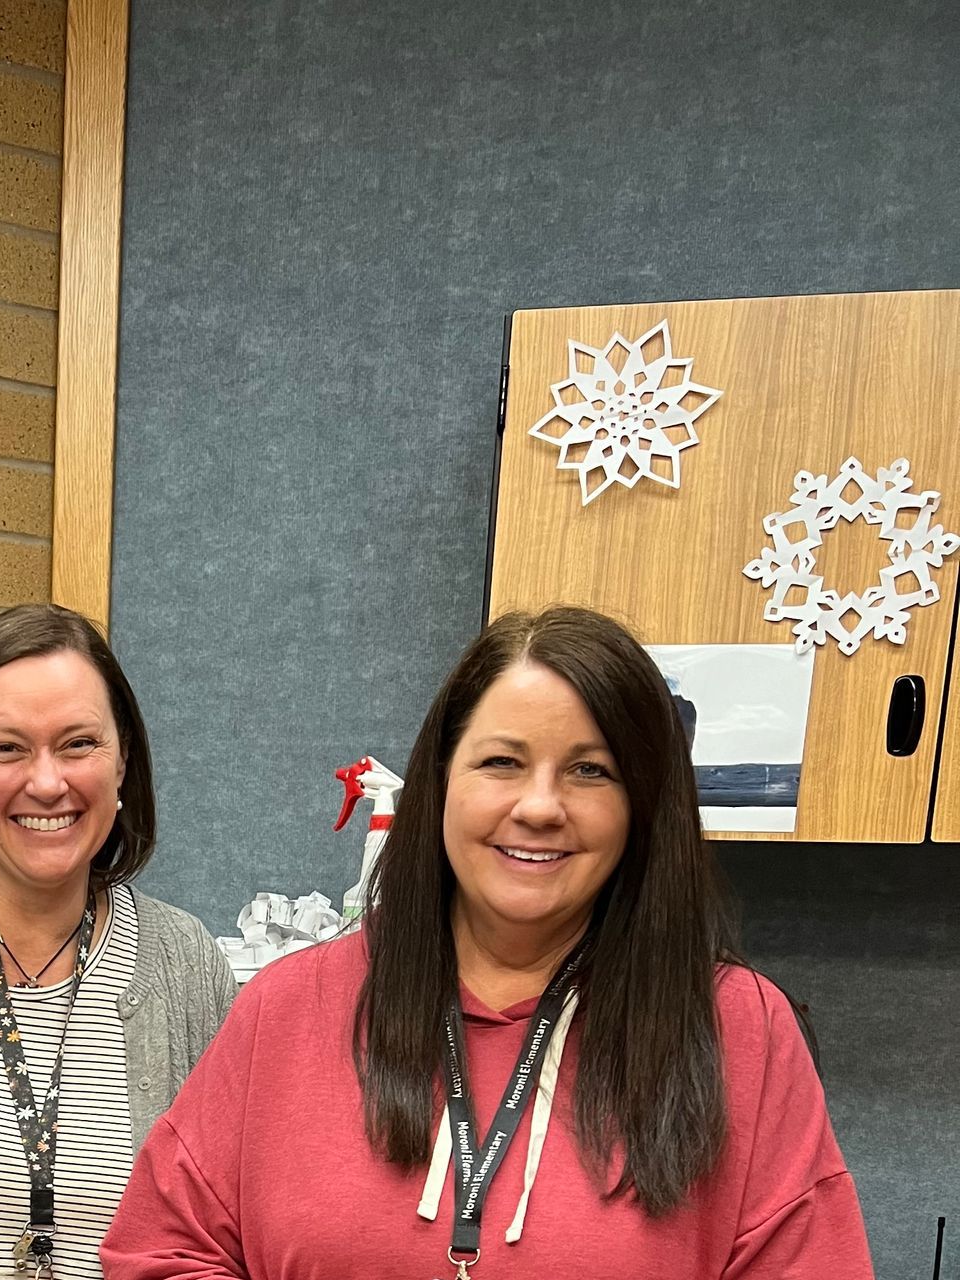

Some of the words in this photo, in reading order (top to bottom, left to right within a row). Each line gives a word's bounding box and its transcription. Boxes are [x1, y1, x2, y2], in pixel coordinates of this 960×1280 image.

[505, 1073, 529, 1110] Moroni
[519, 1018, 551, 1075] Elementary
[457, 1121, 473, 1154] Moroni
[461, 1181, 481, 1219] Moroni
[472, 1130, 508, 1183] Elementary
